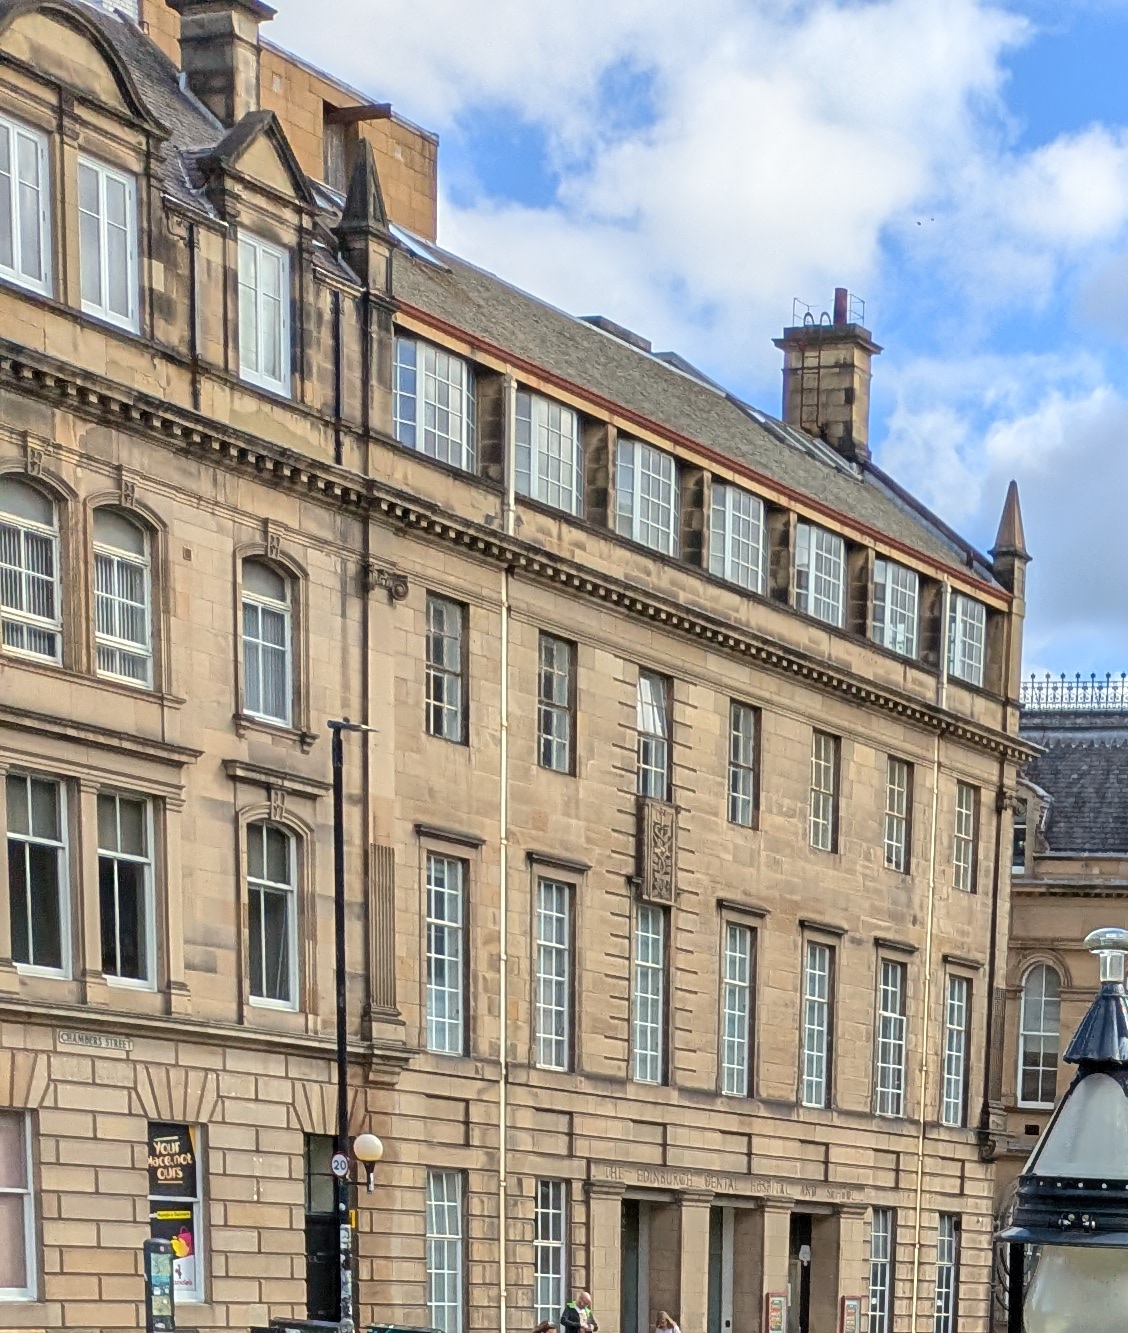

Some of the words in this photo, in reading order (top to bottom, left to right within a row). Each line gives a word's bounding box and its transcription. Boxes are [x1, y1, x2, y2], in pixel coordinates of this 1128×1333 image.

[61, 1032, 103, 1046] CHAMBERS
[105, 1037, 132, 1049] STREET
[153, 1141, 181, 1155] Your
[333, 1160, 347, 1170] 20
[604, 1165, 625, 1180] THE
[637, 1168, 693, 1187] EDINBURGH
[704, 1173, 740, 1191] DENTAL
[751, 1179, 790, 1196] HOSPITAL
[800, 1184, 817, 1198] AND
